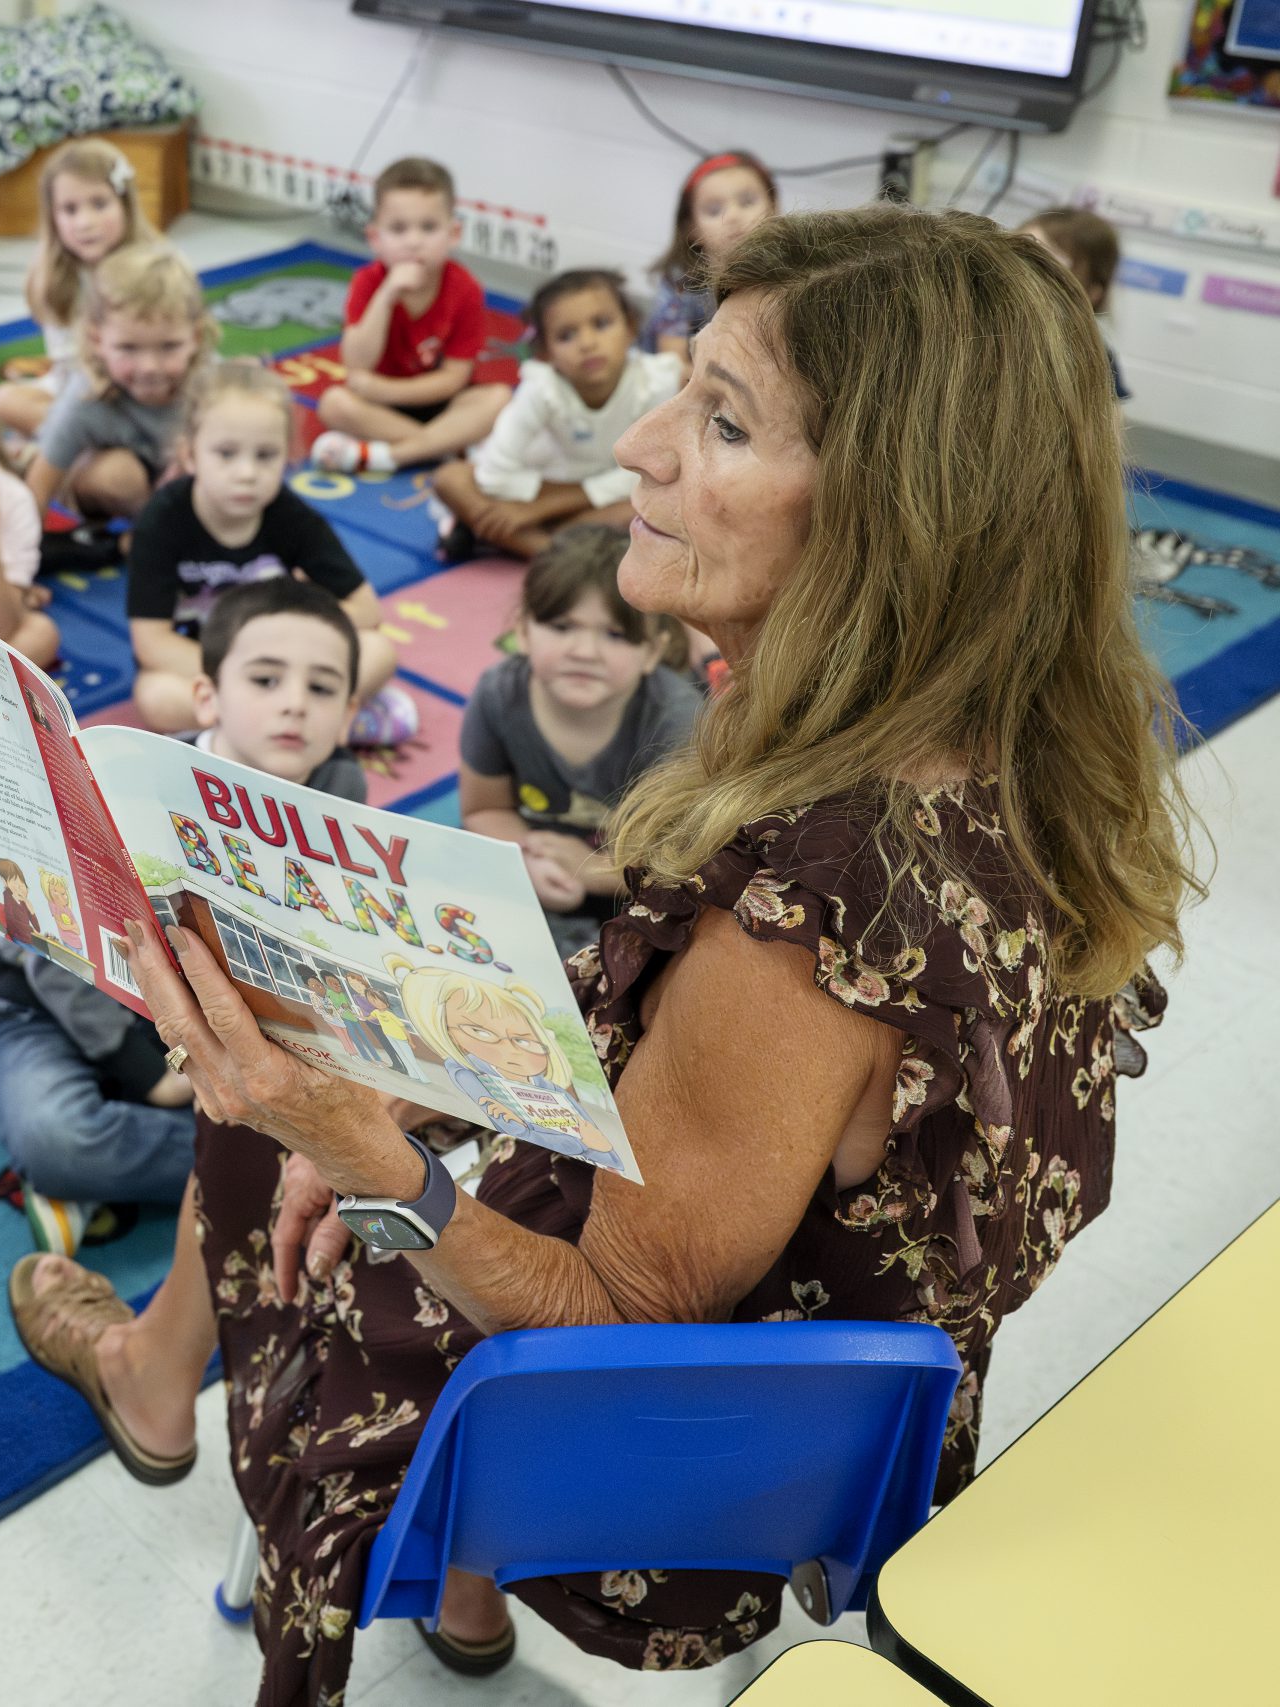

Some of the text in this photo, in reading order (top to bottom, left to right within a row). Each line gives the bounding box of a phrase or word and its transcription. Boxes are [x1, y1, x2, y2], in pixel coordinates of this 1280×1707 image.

[2, 712, 10, 721] to
[191, 766, 409, 887] BULLY
[168, 811, 513, 973] B.E.A.N.S.
[282, 1039, 336, 1063] COOK
